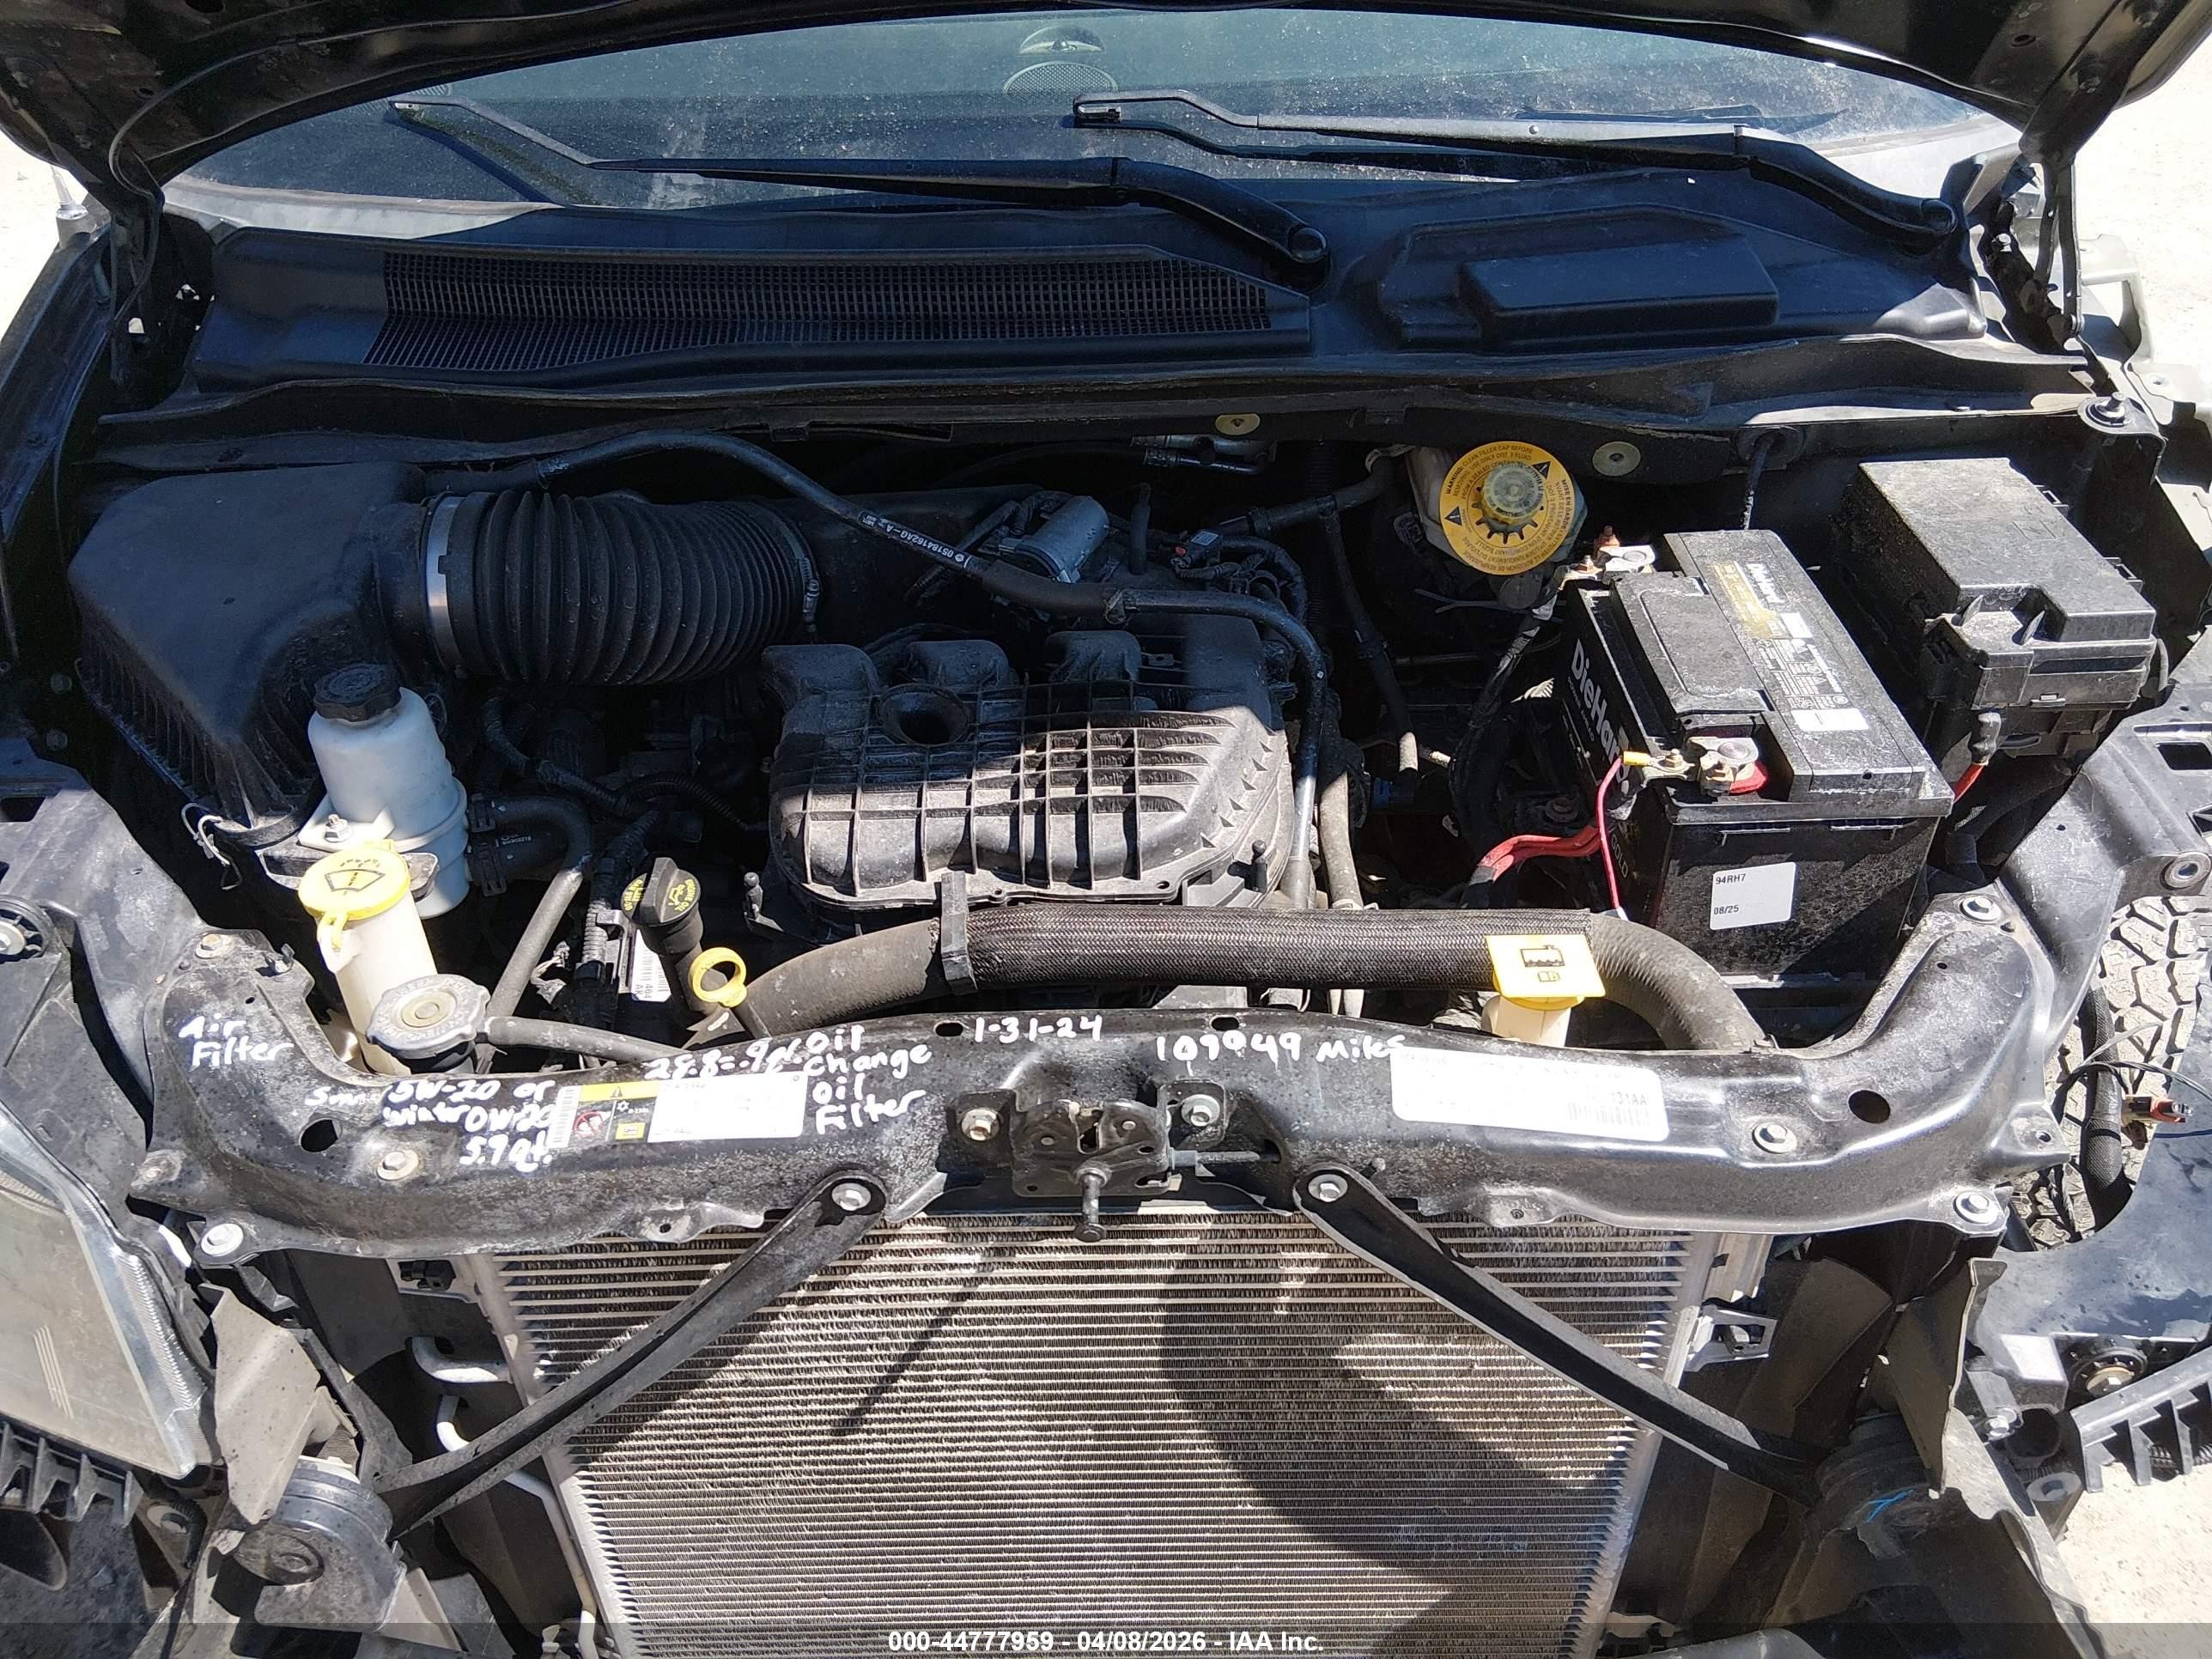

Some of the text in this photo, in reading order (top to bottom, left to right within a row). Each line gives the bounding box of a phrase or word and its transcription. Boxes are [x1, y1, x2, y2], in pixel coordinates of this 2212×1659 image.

[1445, 465, 1464, 495] WARNING:
[1510, 444, 1533, 454] BEFORE
[1480, 453, 1494, 464] ONLY
[1559, 478, 1571, 495] MISE
[1565, 495, 1571, 505] EN
[1610, 834, 1629, 878] GOLD
[1716, 873, 1747, 885] 94RH7
[674, 878, 696, 912] ENGINE OIL
[1713, 904, 1740, 915] 08/25
[179, 1013, 246, 1040] Air
[805, 1024, 865, 1054] Oil
[975, 1014, 1103, 1043] 1-31-24
[190, 1036, 295, 1070] Filter
[386, 1079, 501, 1107] 5W-20
[513, 1079, 556, 1103] or
[812, 1073, 866, 1104] Oil
[815, 1090, 927, 1134] Filter
